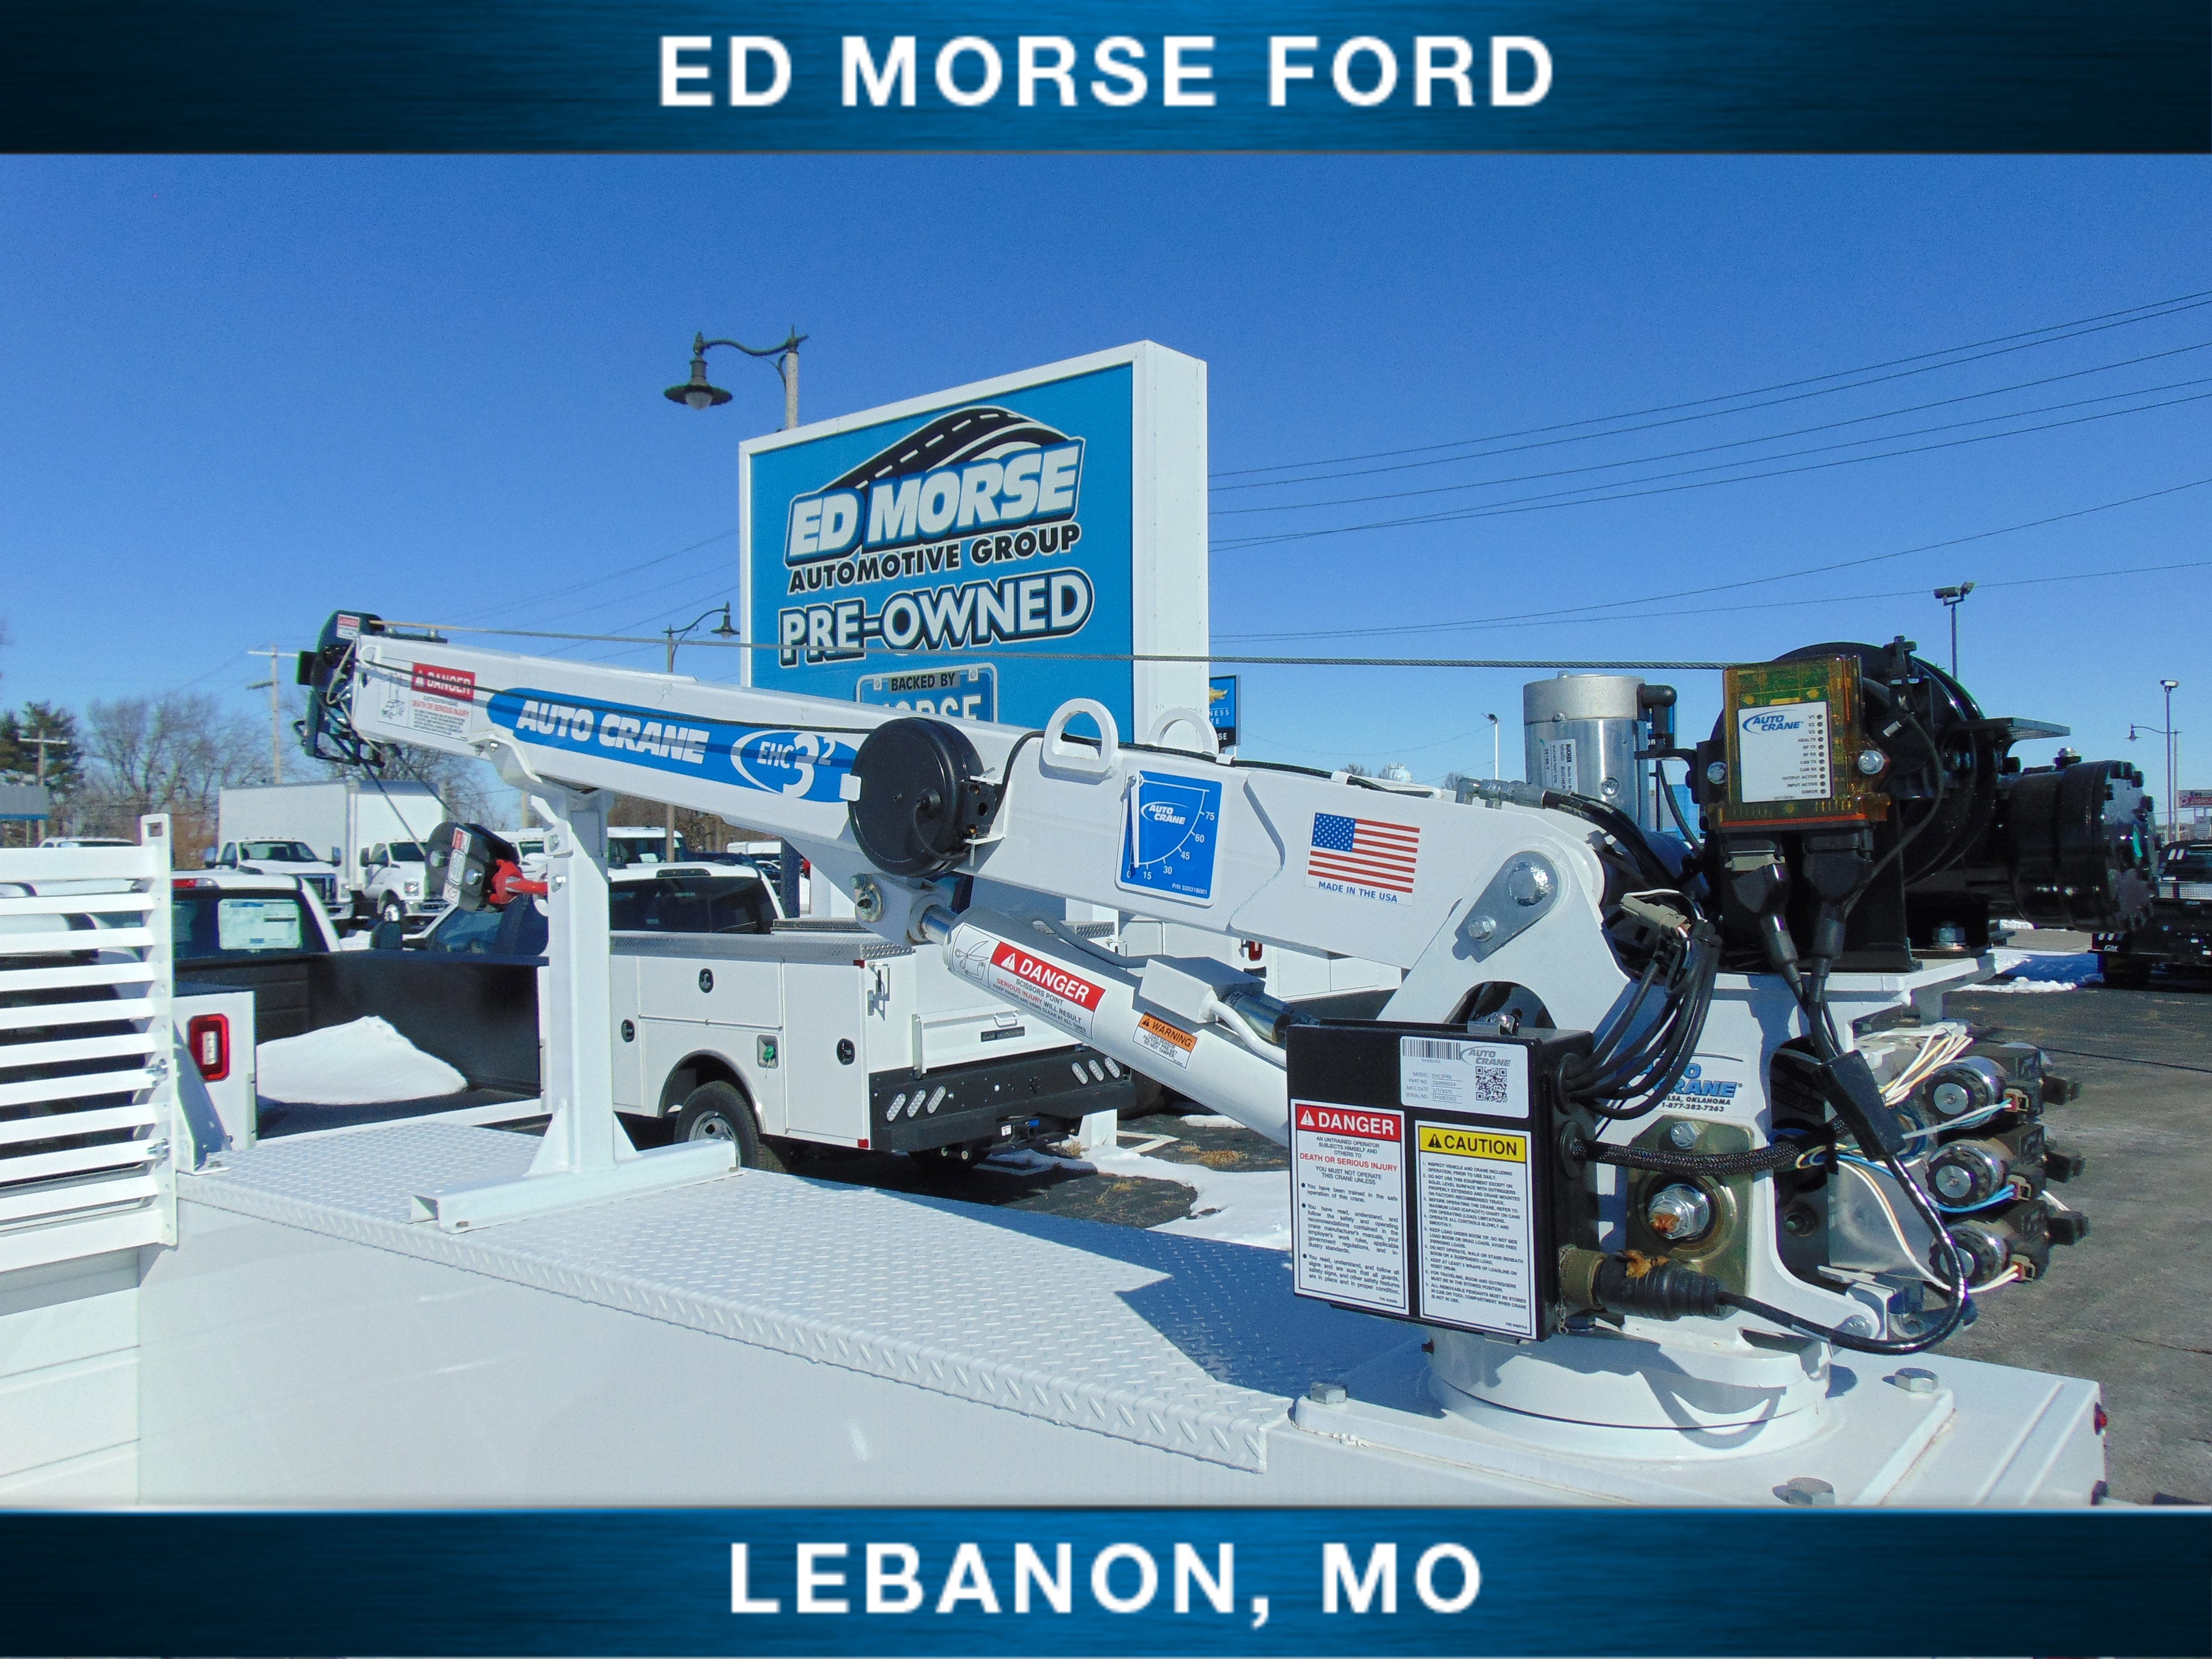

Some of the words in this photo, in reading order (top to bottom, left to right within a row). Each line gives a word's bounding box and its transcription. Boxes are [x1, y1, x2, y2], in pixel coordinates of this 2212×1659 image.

[789, 492, 859, 558] ED
[867, 444, 1080, 544] MORSE
[789, 544, 960, 594] AUTOMOTIVE
[971, 523, 1080, 565] GROUP
[781, 574, 1090, 662] PRE-OWNED
[891, 675, 935, 692] BACKED
[940, 673, 955, 687] BY
[1753, 715, 1784, 725] AUTO
[1761, 721, 1801, 731] CRANE
[516, 700, 595, 742] AUTO
[599, 714, 710, 765] CRANE
[1149, 805, 1174, 814] AUTO
[1154, 813, 1186, 824] CRANE
[1205, 811, 1215, 820] 75
[1195, 834, 1204, 842] 60
[1181, 851, 1190, 860] 45
[1143, 871, 1152, 880] 15
[1163, 866, 1172, 874] 30
[1182, 885, 1207, 895] 320318001
[1319, 881, 1343, 892] MADE
[1346, 886, 1355, 894] IN
[1358, 888, 1376, 898] THE
[1379, 892, 1397, 902] USA
[1019, 958, 1089, 1003] DANGER
[1016, 978, 1045, 997] SCISSORS
[1046, 993, 1064, 1006] POINT
[997, 978, 1021, 994] SERIOUS
[1022, 990, 1042, 1004] INJURY
[1044, 1000, 1057, 1012] WILL
[1059, 1008, 1082, 1024] RESULT
[1042, 1007, 1057, 1018] CLEAR
[1152, 1021, 1192, 1047] WARNING
[1143, 1035, 1160, 1046] FACTORY
[1148, 1032, 1159, 1041] LOAD
[1160, 1036, 1176, 1049] SENSOR
[1159, 1047, 1175, 1058] TAMPER
[1468, 1049, 1496, 1057] AUTO
[1475, 1057, 1511, 1066] CRANE
[1672, 1079, 1738, 1098] RANE
[1686, 1096, 1731, 1105] OKLAHOMA
[1662, 1102, 1725, 1112] 1-877-282-7263
[1319, 1112, 1394, 1136] DANGER
[1319, 1142, 1344, 1150] SUBJECTS
[1324, 1137, 1352, 1145] UNTRAINED
[1353, 1140, 1380, 1149] OPERATOR
[1444, 1136, 1517, 1156] CAUTION
[1300, 1152, 1323, 1162] DEATH
[1325, 1156, 1335, 1164] OR
[1337, 1158, 1369, 1168] SERIOUS
[1371, 1162, 1398, 1172] INJURY
[1354, 1177, 1376, 1185] UNLESS
[1357, 1171, 1382, 1180] OPERATE
[1307, 1210, 1322, 1218] follow
[1375, 1221, 1399, 1230] operating
[1355, 1212, 1384, 1221] understand,
[1308, 1217, 1350, 1228] recommendations
[1353, 1224, 1378, 1233] contained
